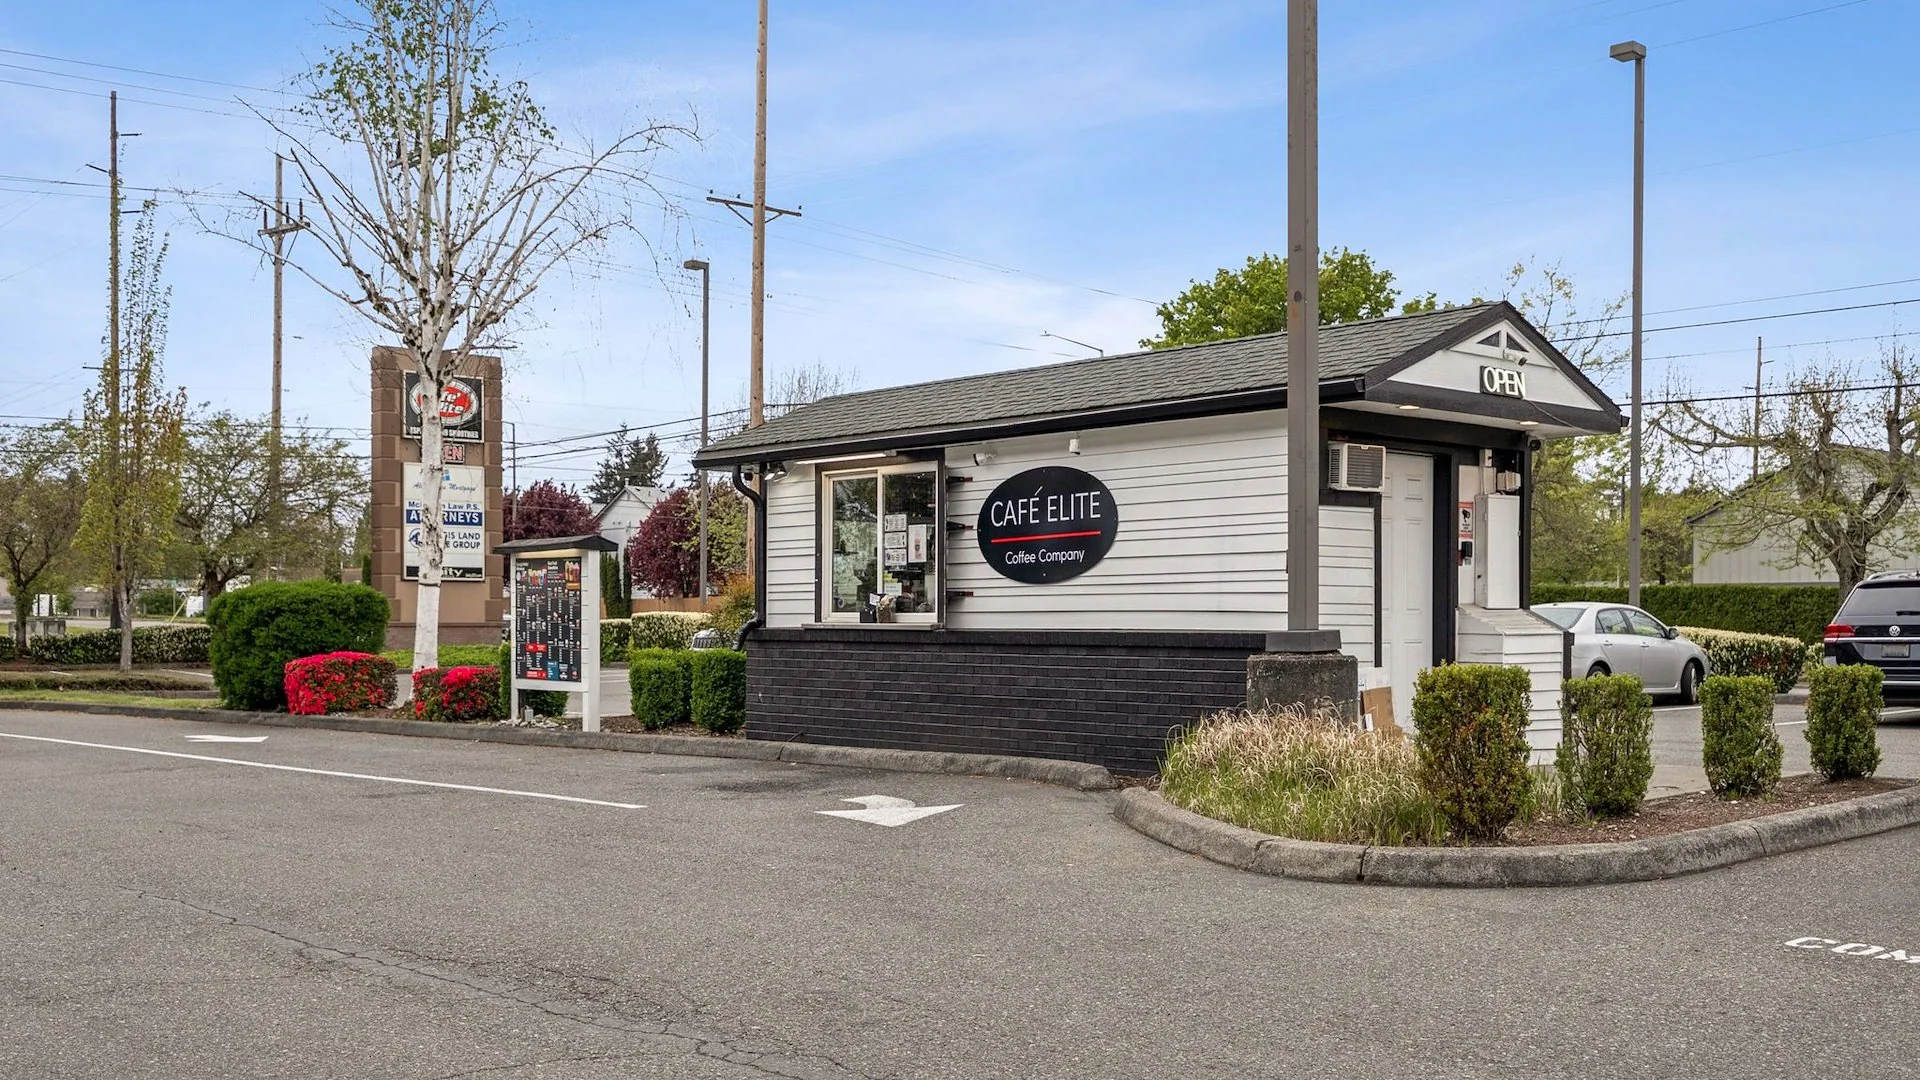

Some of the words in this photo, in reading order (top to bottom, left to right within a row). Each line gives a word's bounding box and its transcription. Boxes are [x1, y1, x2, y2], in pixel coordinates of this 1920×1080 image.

[1483, 367, 1526, 397] OPEN
[991, 486, 1043, 527] CAFÉ
[1047, 491, 1101, 522] ELITE
[410, 511, 479, 523] ATRNEYS
[458, 532, 480, 540] LAND
[453, 541, 480, 549] GROUP
[1005, 550, 1036, 565] Coffee
[1038, 548, 1085, 564] Company
